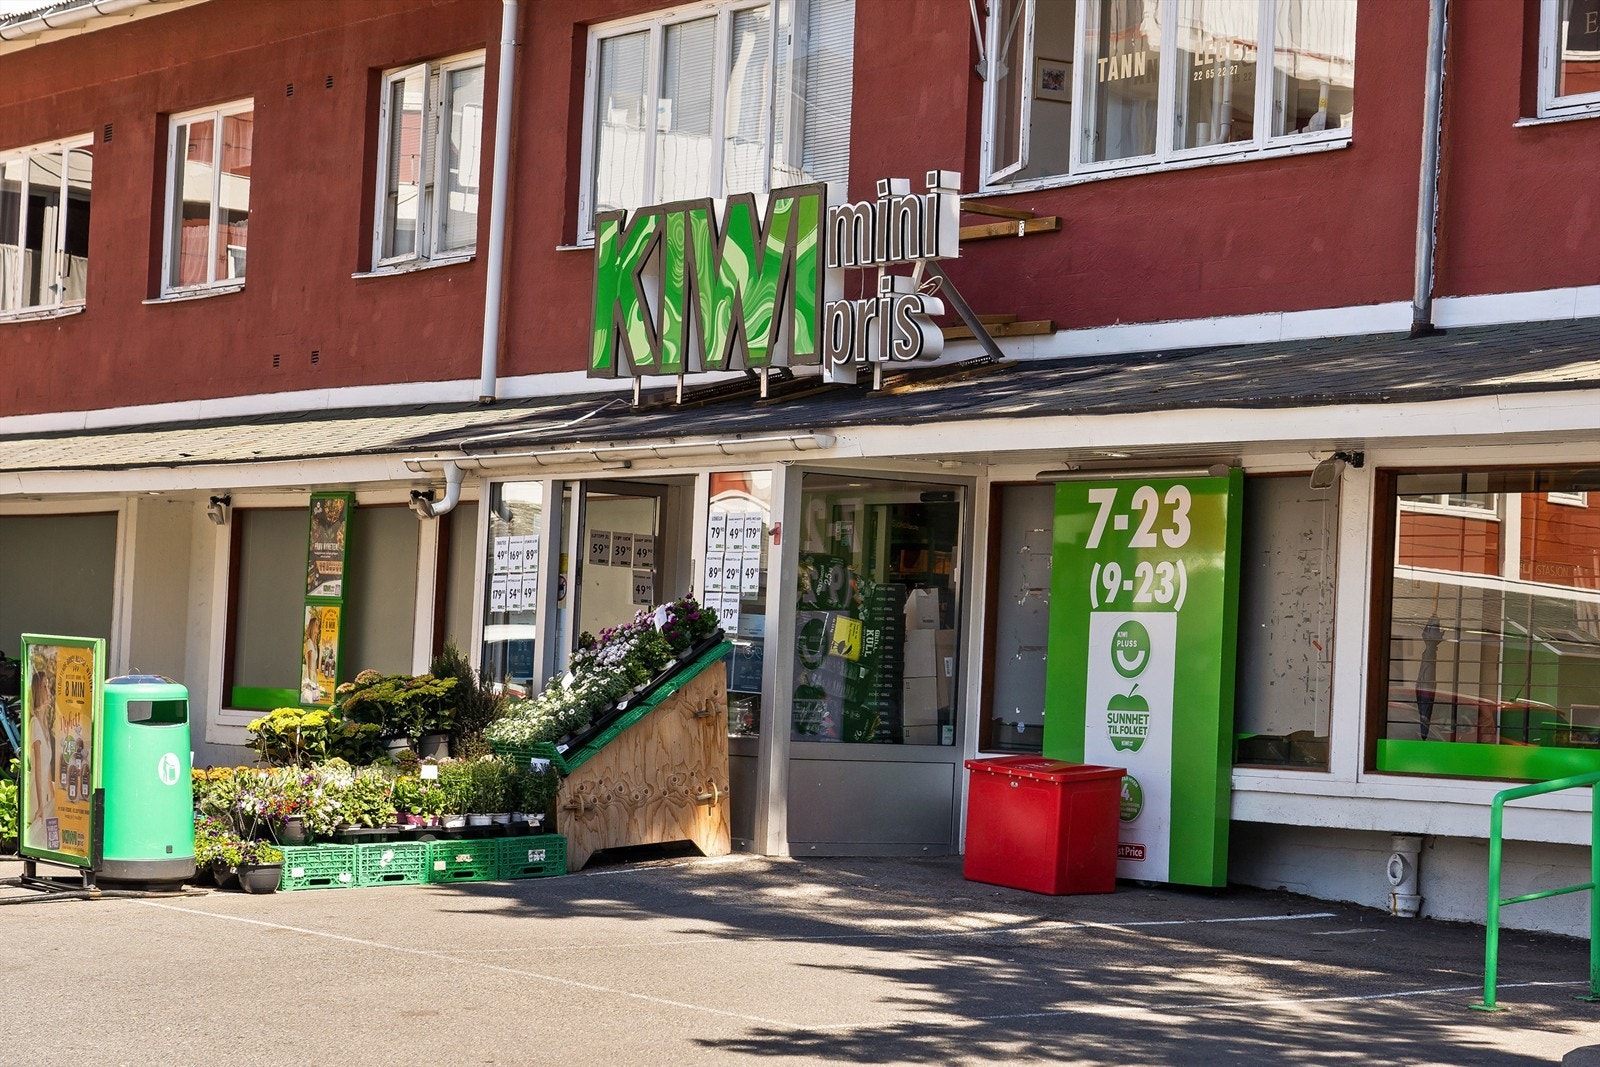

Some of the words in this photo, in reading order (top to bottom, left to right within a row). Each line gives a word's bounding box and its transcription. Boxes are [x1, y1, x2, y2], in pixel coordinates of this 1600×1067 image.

[1584, 11, 1600, 34] E
[1097, 51, 1146, 83] TANN
[1193, 70, 1203, 81] 22
[1205, 68, 1215, 79] 65
[1217, 66, 1227, 77] 22
[1229, 64, 1238, 75] 27
[828, 170, 948, 268] mini
[587, 182, 829, 379] KIWI
[823, 276, 938, 383] pris
[1085, 484, 1192, 549] 7-23
[711, 527, 720, 538] 79
[730, 528, 738, 539] 49
[746, 528, 756, 538] 179
[592, 544, 604, 554] 59
[615, 546, 626, 556] 39
[636, 548, 647, 558] 49
[497, 550, 504, 560] 49
[708, 566, 718, 578] 89
[726, 568, 735, 580] 29
[745, 568, 754, 579] 49
[636, 584, 646, 594] 49
[1090, 559, 1188, 612] (9-23)
[509, 588, 517, 599] 54
[524, 588, 532, 598] 49
[723, 608, 733, 619] 179
[864, 629, 874, 657] KULL
[1116, 639, 1137, 648] PLUSS
[65, 681, 69, 696] 8
[72, 681, 84, 698] MIN
[1107, 713, 1149, 725] SUNNHET
[1108, 725, 1119, 734] TIL
[1120, 725, 1148, 735] FOLKET
[1125, 846, 1143, 857] Price
